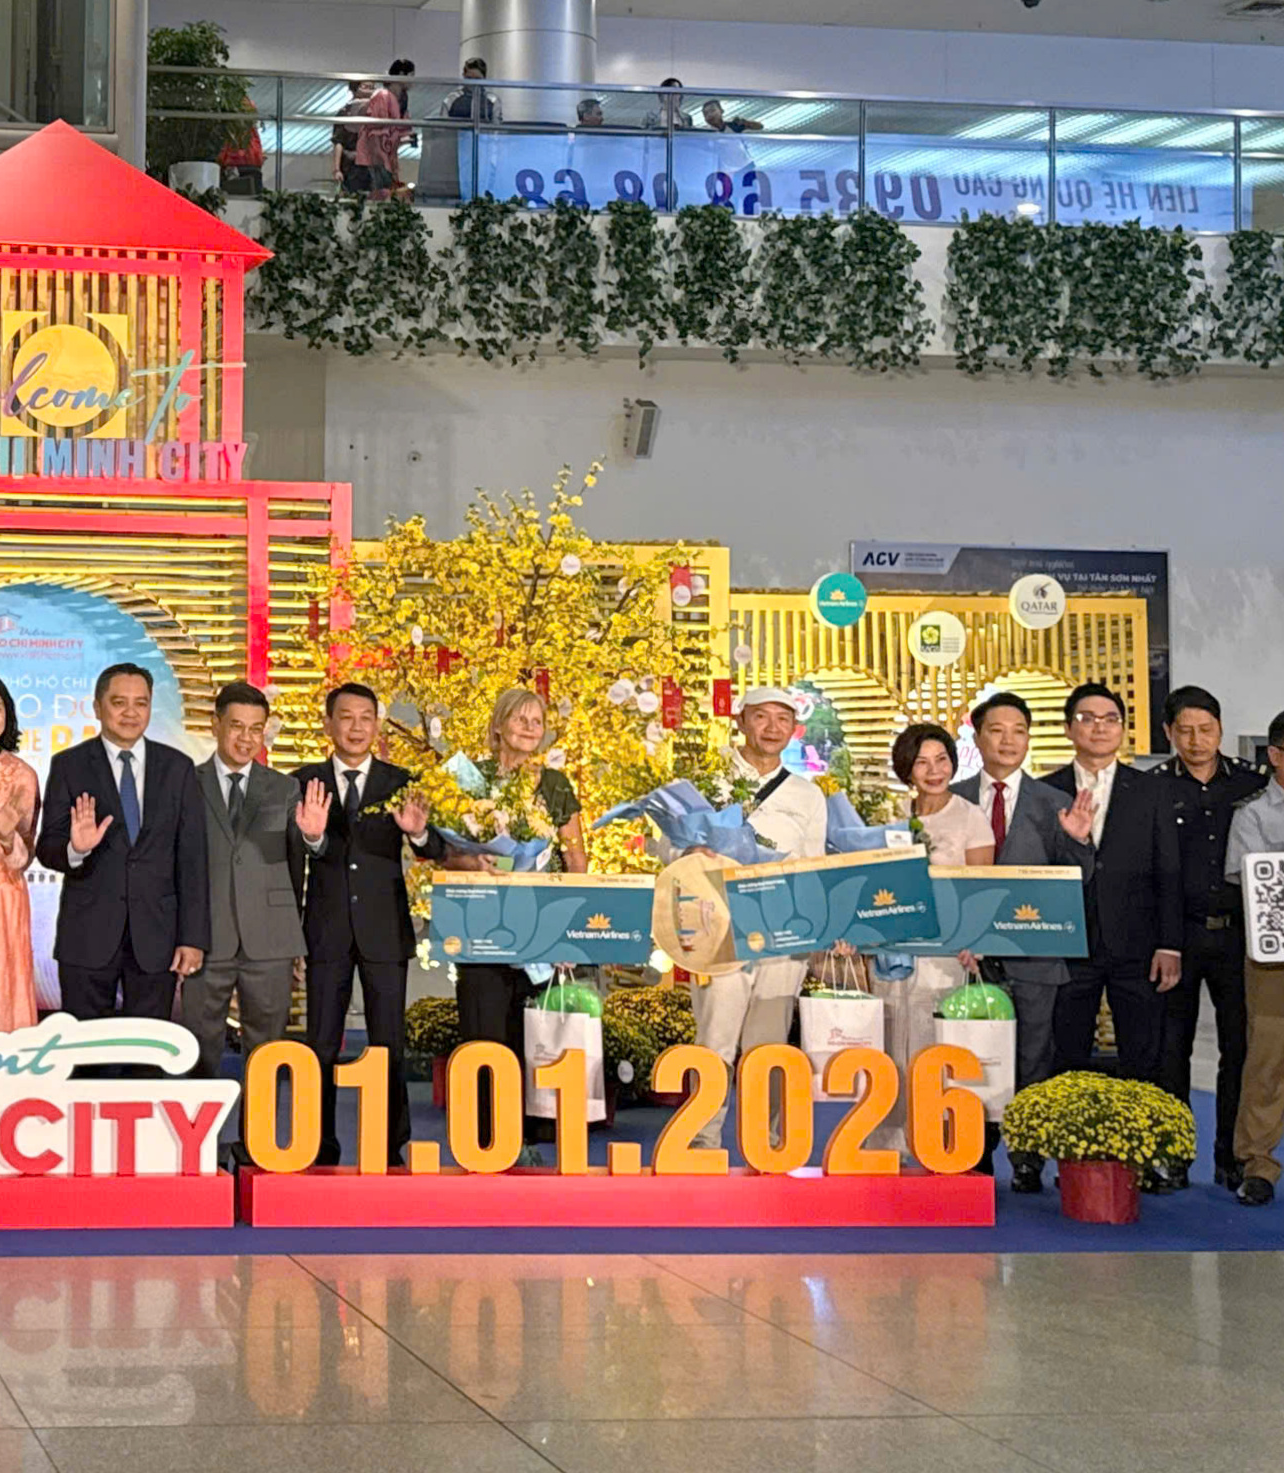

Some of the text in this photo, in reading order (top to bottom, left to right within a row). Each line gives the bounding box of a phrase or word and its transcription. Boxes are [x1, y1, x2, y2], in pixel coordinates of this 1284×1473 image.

[42, 437, 146, 479] MINH
[160, 441, 248, 482] CITY
[862, 552, 901, 566] ACV
[1021, 600, 1058, 612] QATAR
[245, 1040, 985, 1176] 01.01.2026
